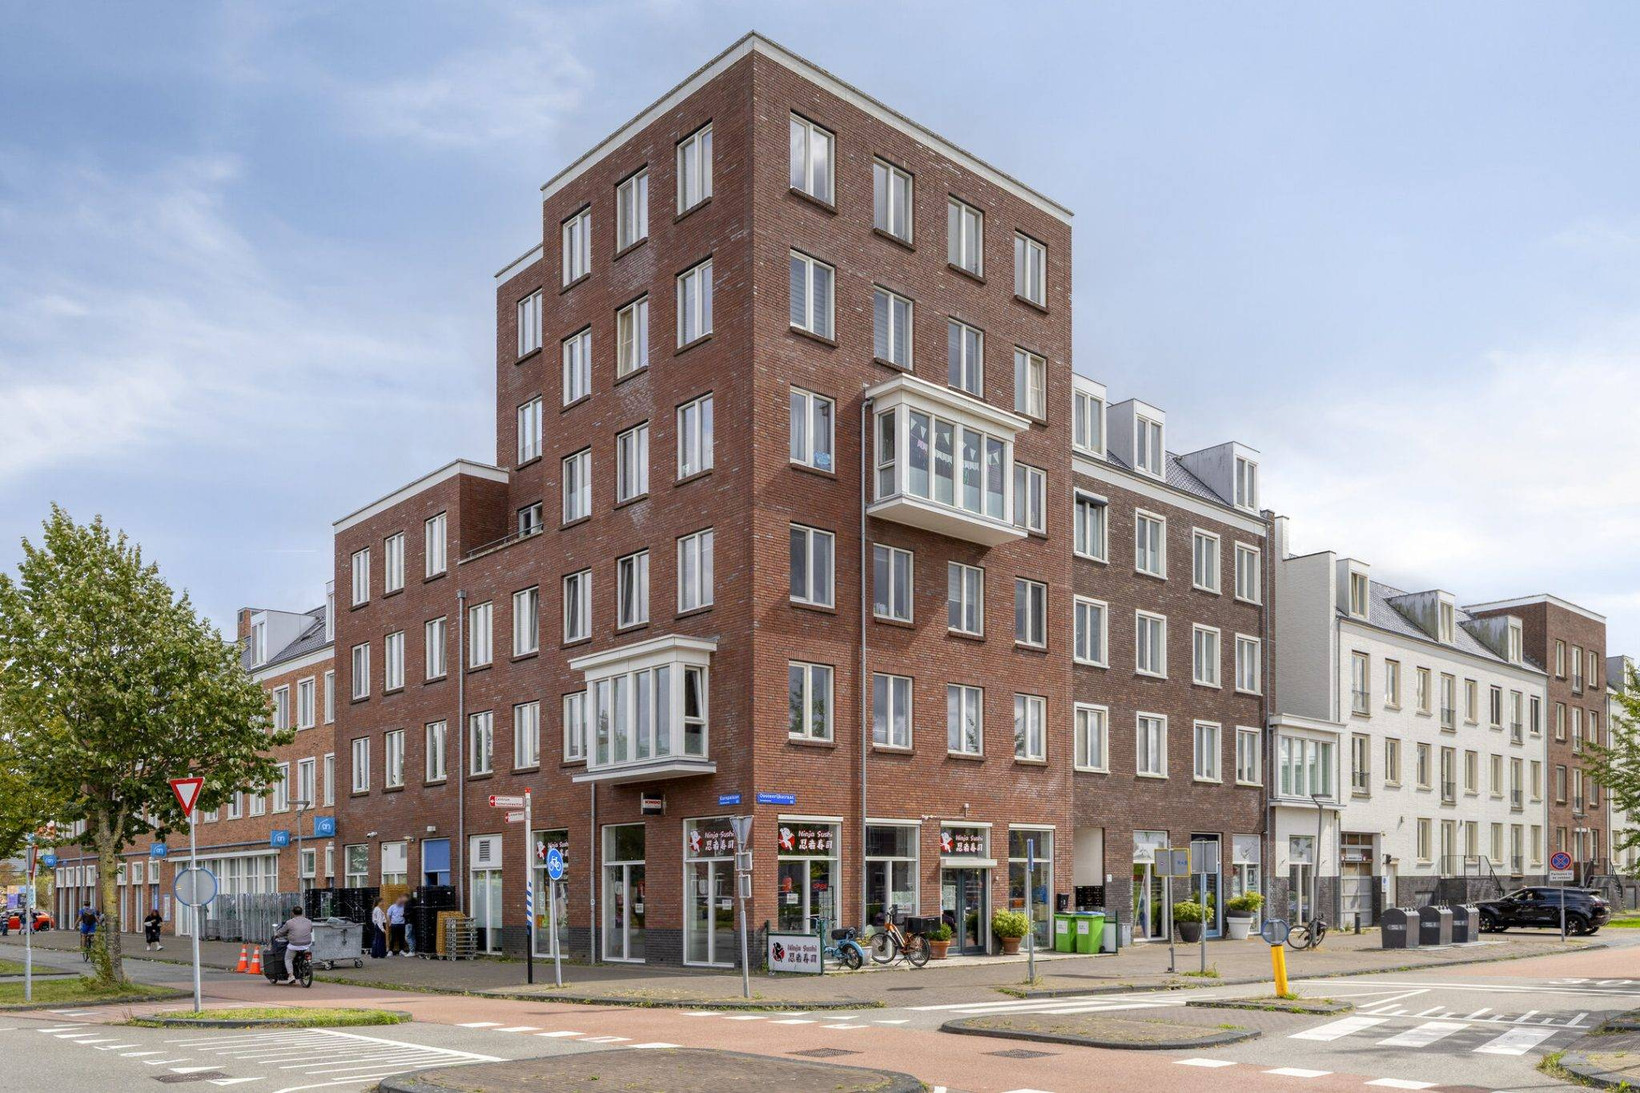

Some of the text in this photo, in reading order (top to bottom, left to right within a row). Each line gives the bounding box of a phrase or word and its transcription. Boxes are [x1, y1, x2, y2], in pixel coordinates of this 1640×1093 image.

[704, 831, 719, 839] Ninja
[798, 830, 833, 838] Ninja Sushi
[787, 944, 801, 952] Ninja
